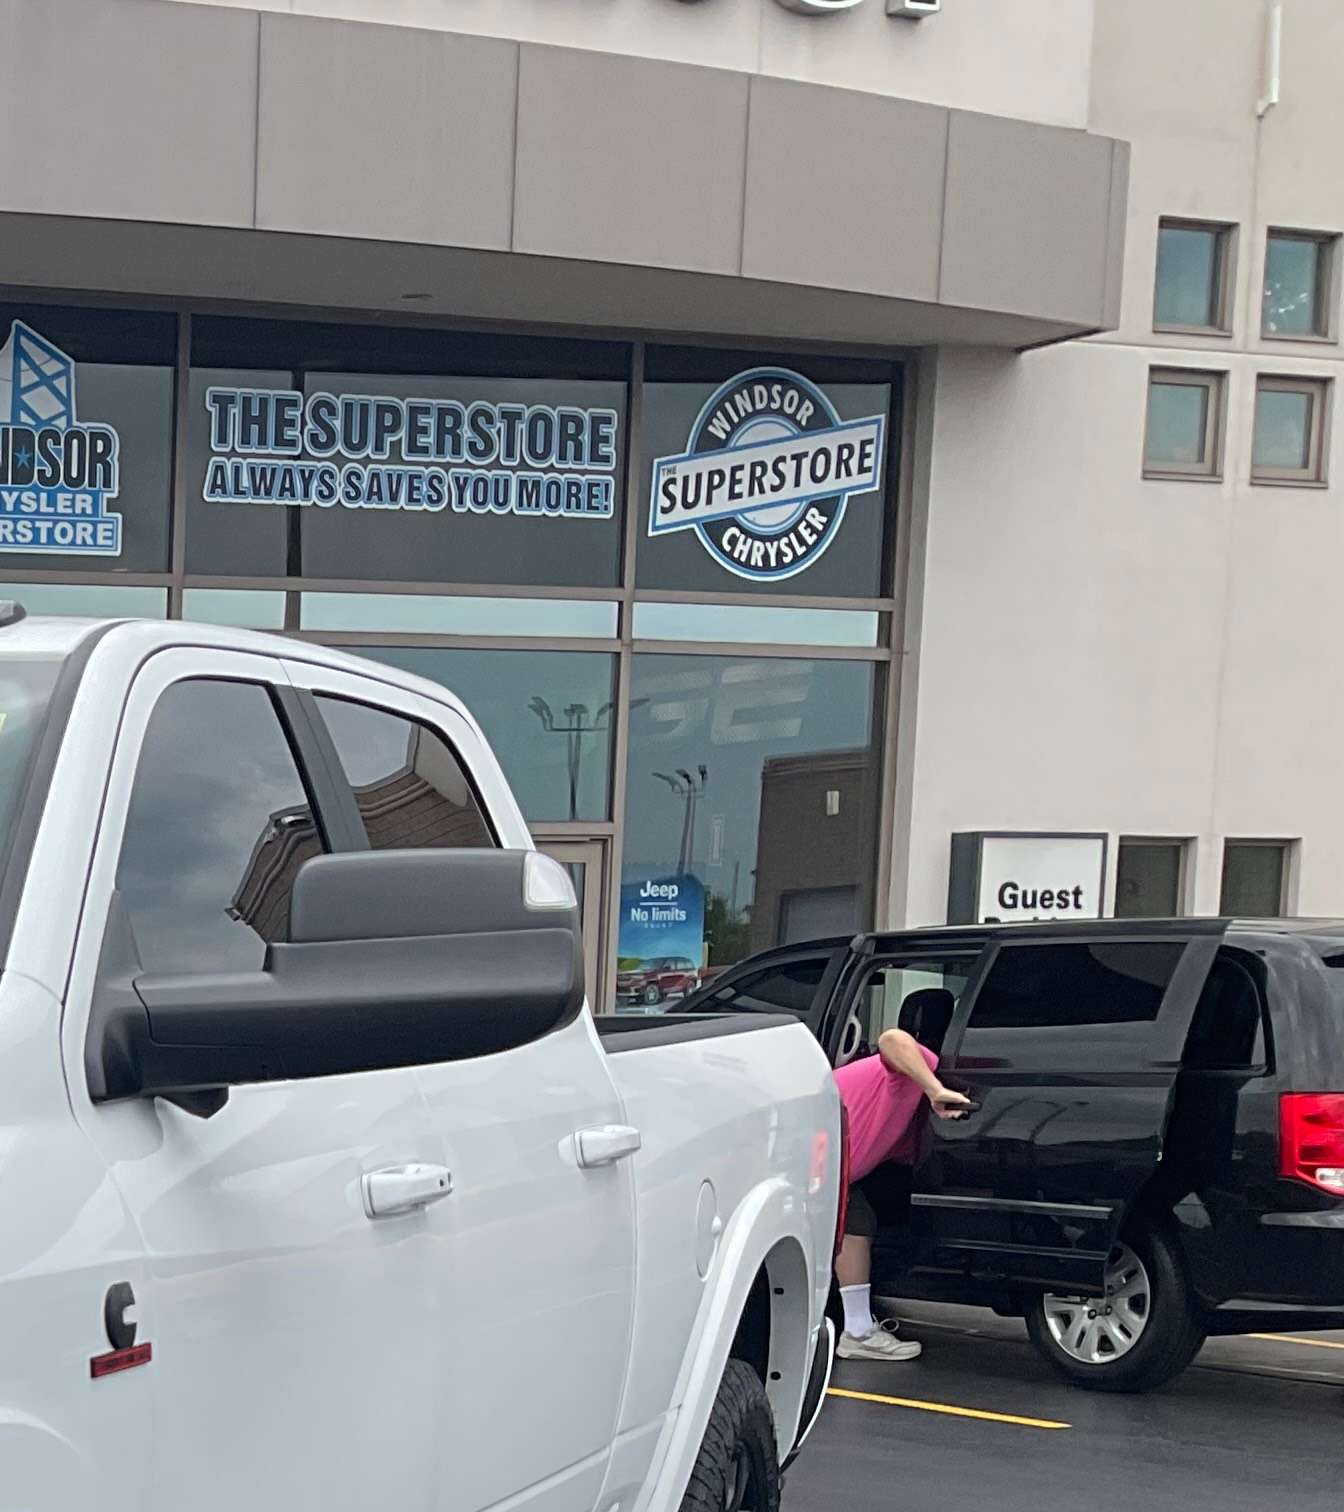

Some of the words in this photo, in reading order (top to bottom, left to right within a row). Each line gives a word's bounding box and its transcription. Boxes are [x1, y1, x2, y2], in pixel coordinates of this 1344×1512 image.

[210, 391, 300, 450] THE
[306, 397, 614, 466] SUPERSTORE
[706, 383, 815, 441] WINDSOR
[211, 463, 337, 504] ALWAYS
[342, 467, 446, 507] SAVES
[452, 474, 512, 511] YOU
[516, 476, 612, 513] MORE!
[659, 437, 875, 516] SUPERSTORE
[661, 464, 678, 476] THE
[721, 506, 829, 568] CHRYSLER
[630, 907, 649, 921] No
[651, 907, 687, 921] limits
[639, 880, 679, 901] Jeep
[997, 881, 1083, 910] Guest
